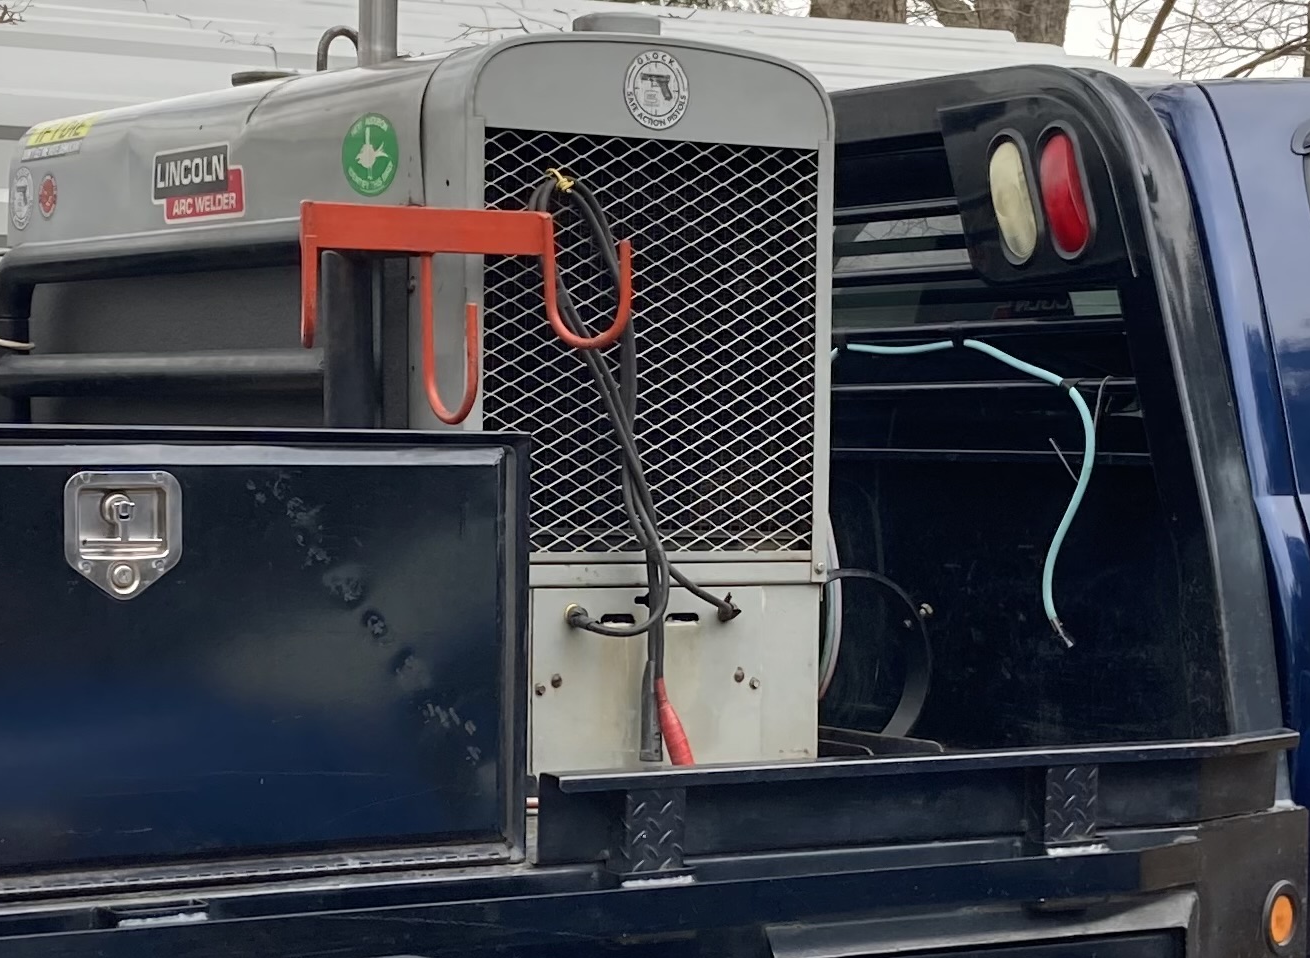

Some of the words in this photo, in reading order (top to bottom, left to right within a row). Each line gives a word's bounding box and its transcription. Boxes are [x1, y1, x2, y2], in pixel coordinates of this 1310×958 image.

[637, 112, 666, 127] ACTION
[666, 95, 686, 123] PISTOLS
[156, 153, 225, 189] LINCOLN
[172, 198, 194, 216] ARC
[194, 193, 237, 213] WELDER
